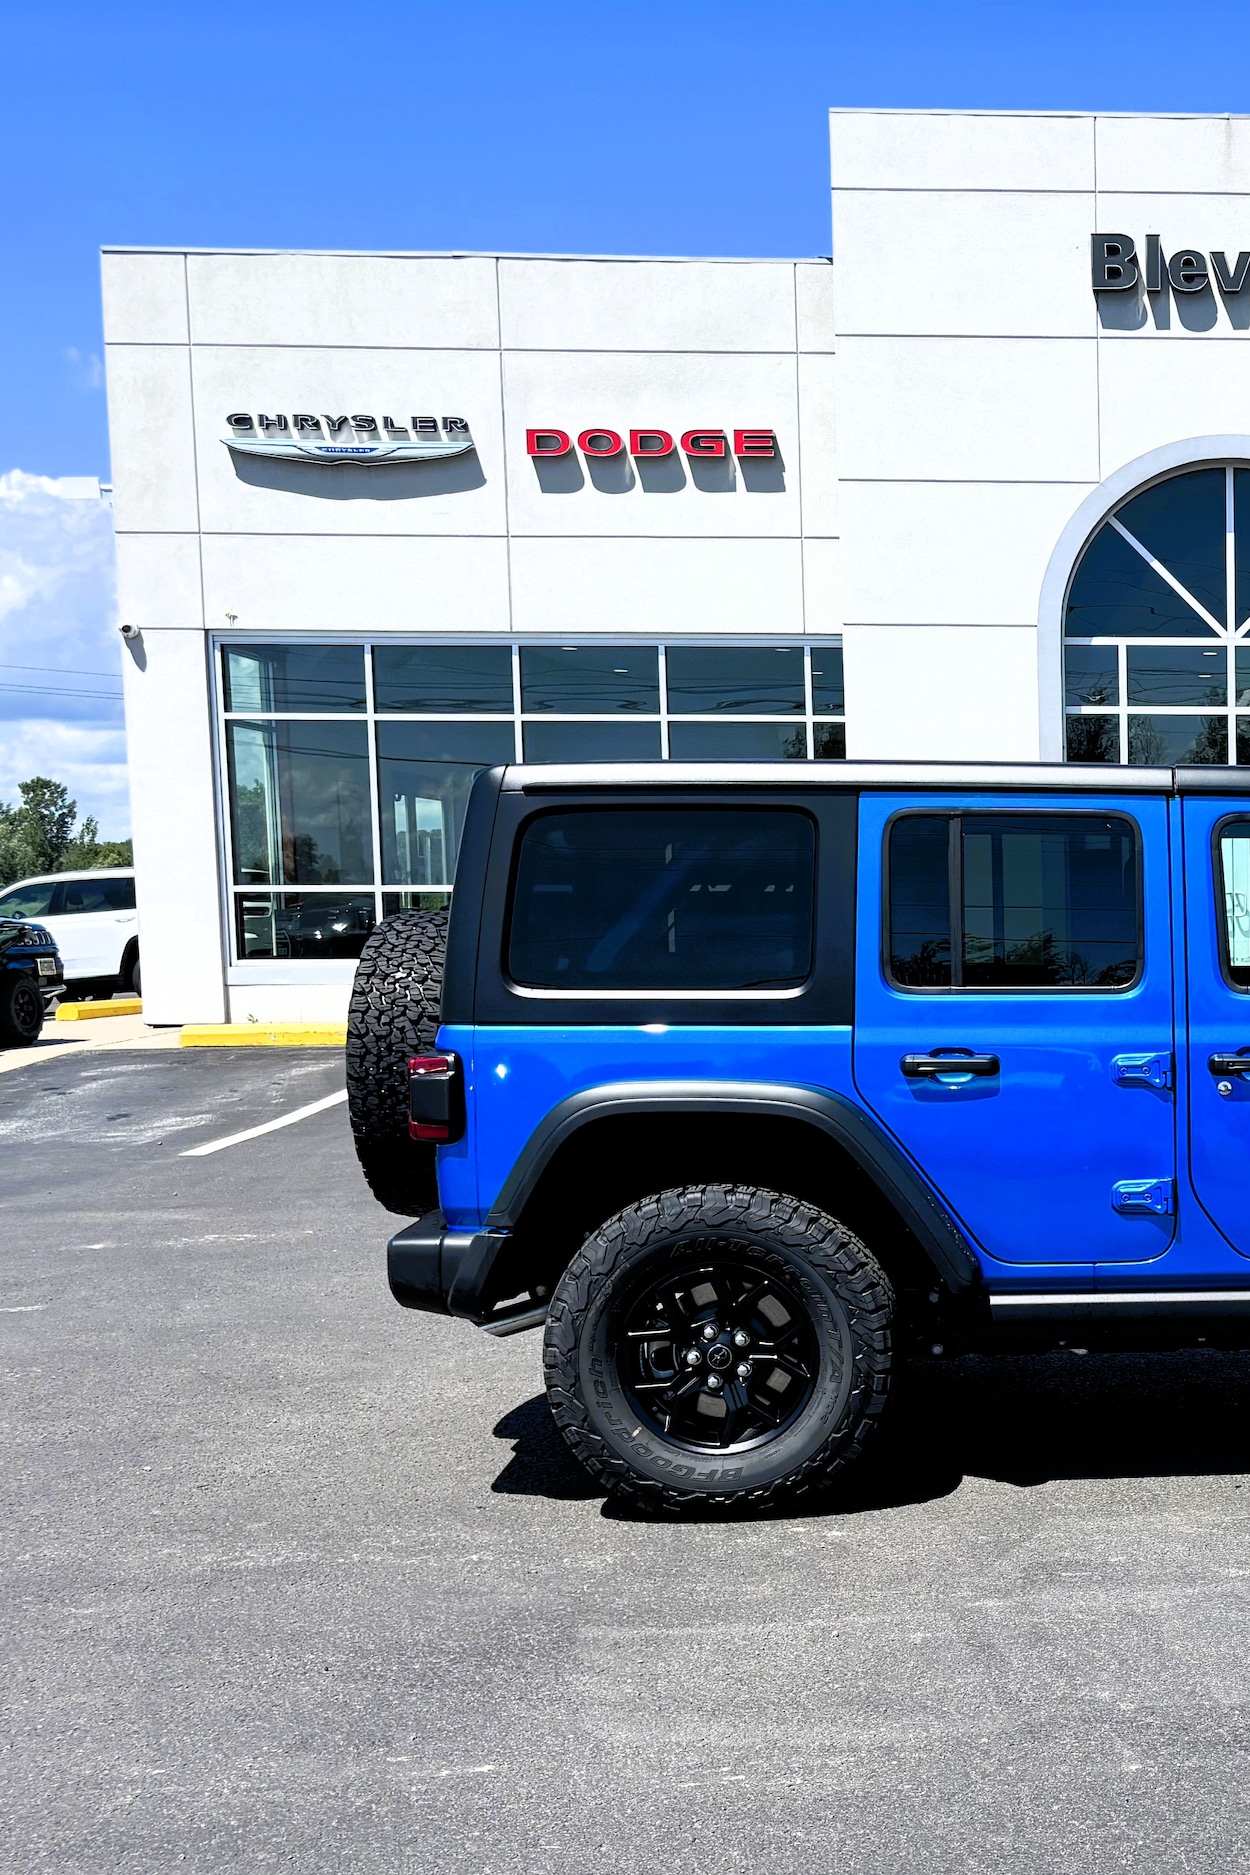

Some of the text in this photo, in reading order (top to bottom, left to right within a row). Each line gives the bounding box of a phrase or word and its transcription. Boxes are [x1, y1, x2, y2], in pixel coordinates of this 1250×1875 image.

[226, 412, 470, 433] CHRYSLER
[526, 428, 775, 457] DODGE
[589, 1357, 743, 1483] BFGoodrich
